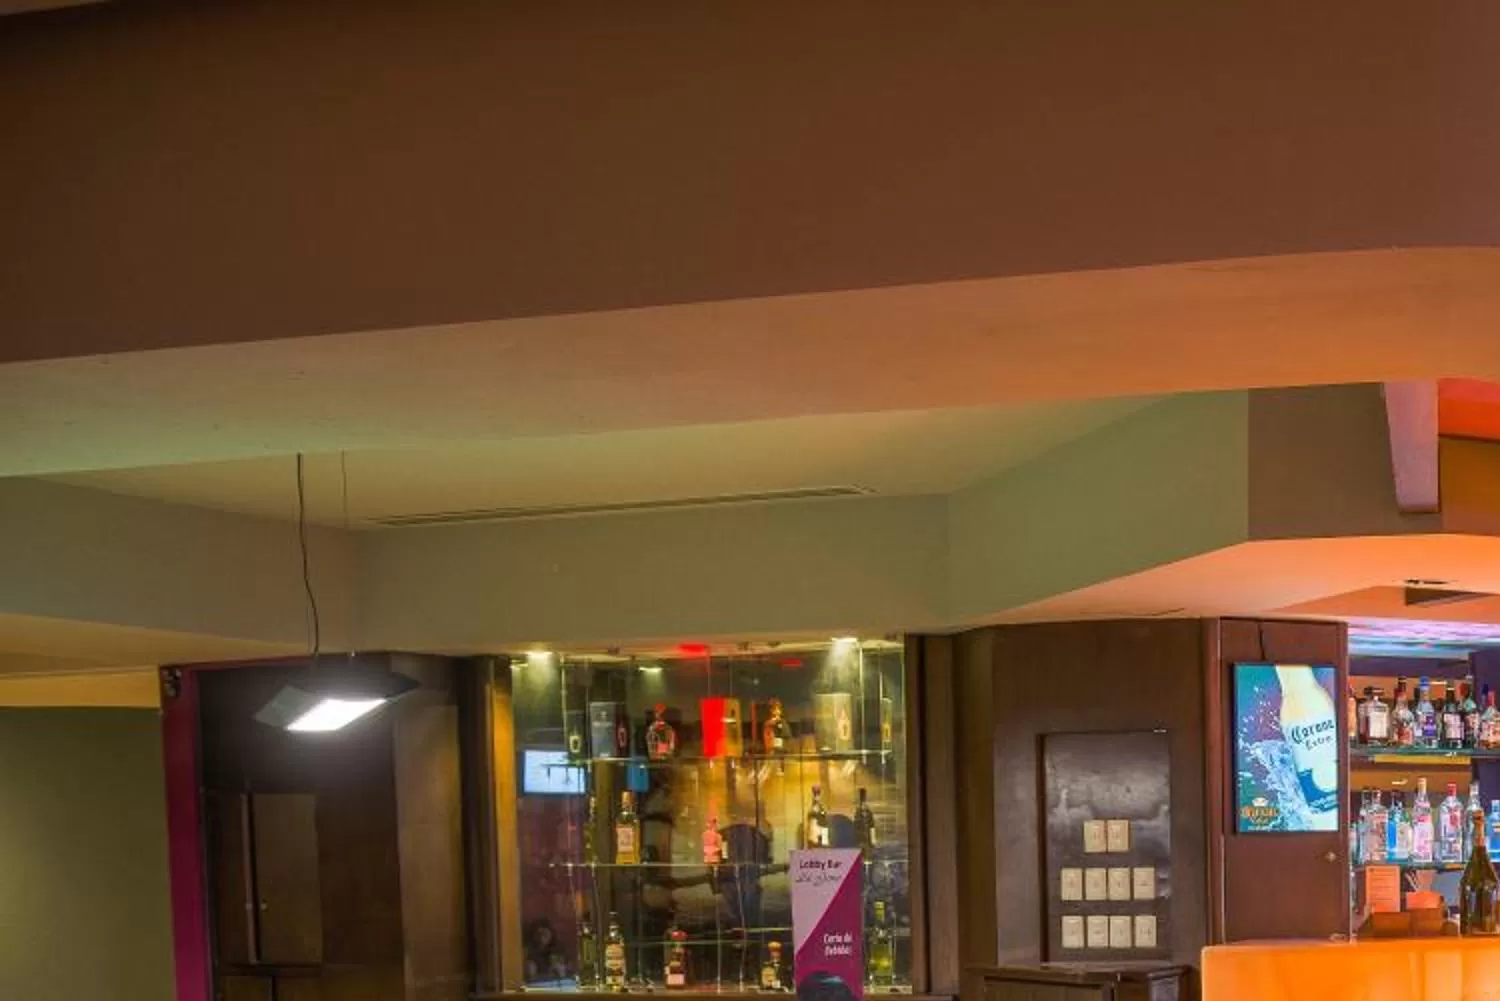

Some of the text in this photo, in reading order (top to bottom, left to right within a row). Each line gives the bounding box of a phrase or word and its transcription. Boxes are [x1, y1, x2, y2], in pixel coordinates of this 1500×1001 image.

[1291, 719, 1335, 744] Corona
[1305, 735, 1332, 751] Extra
[799, 859, 843, 870] Lobby Bar
